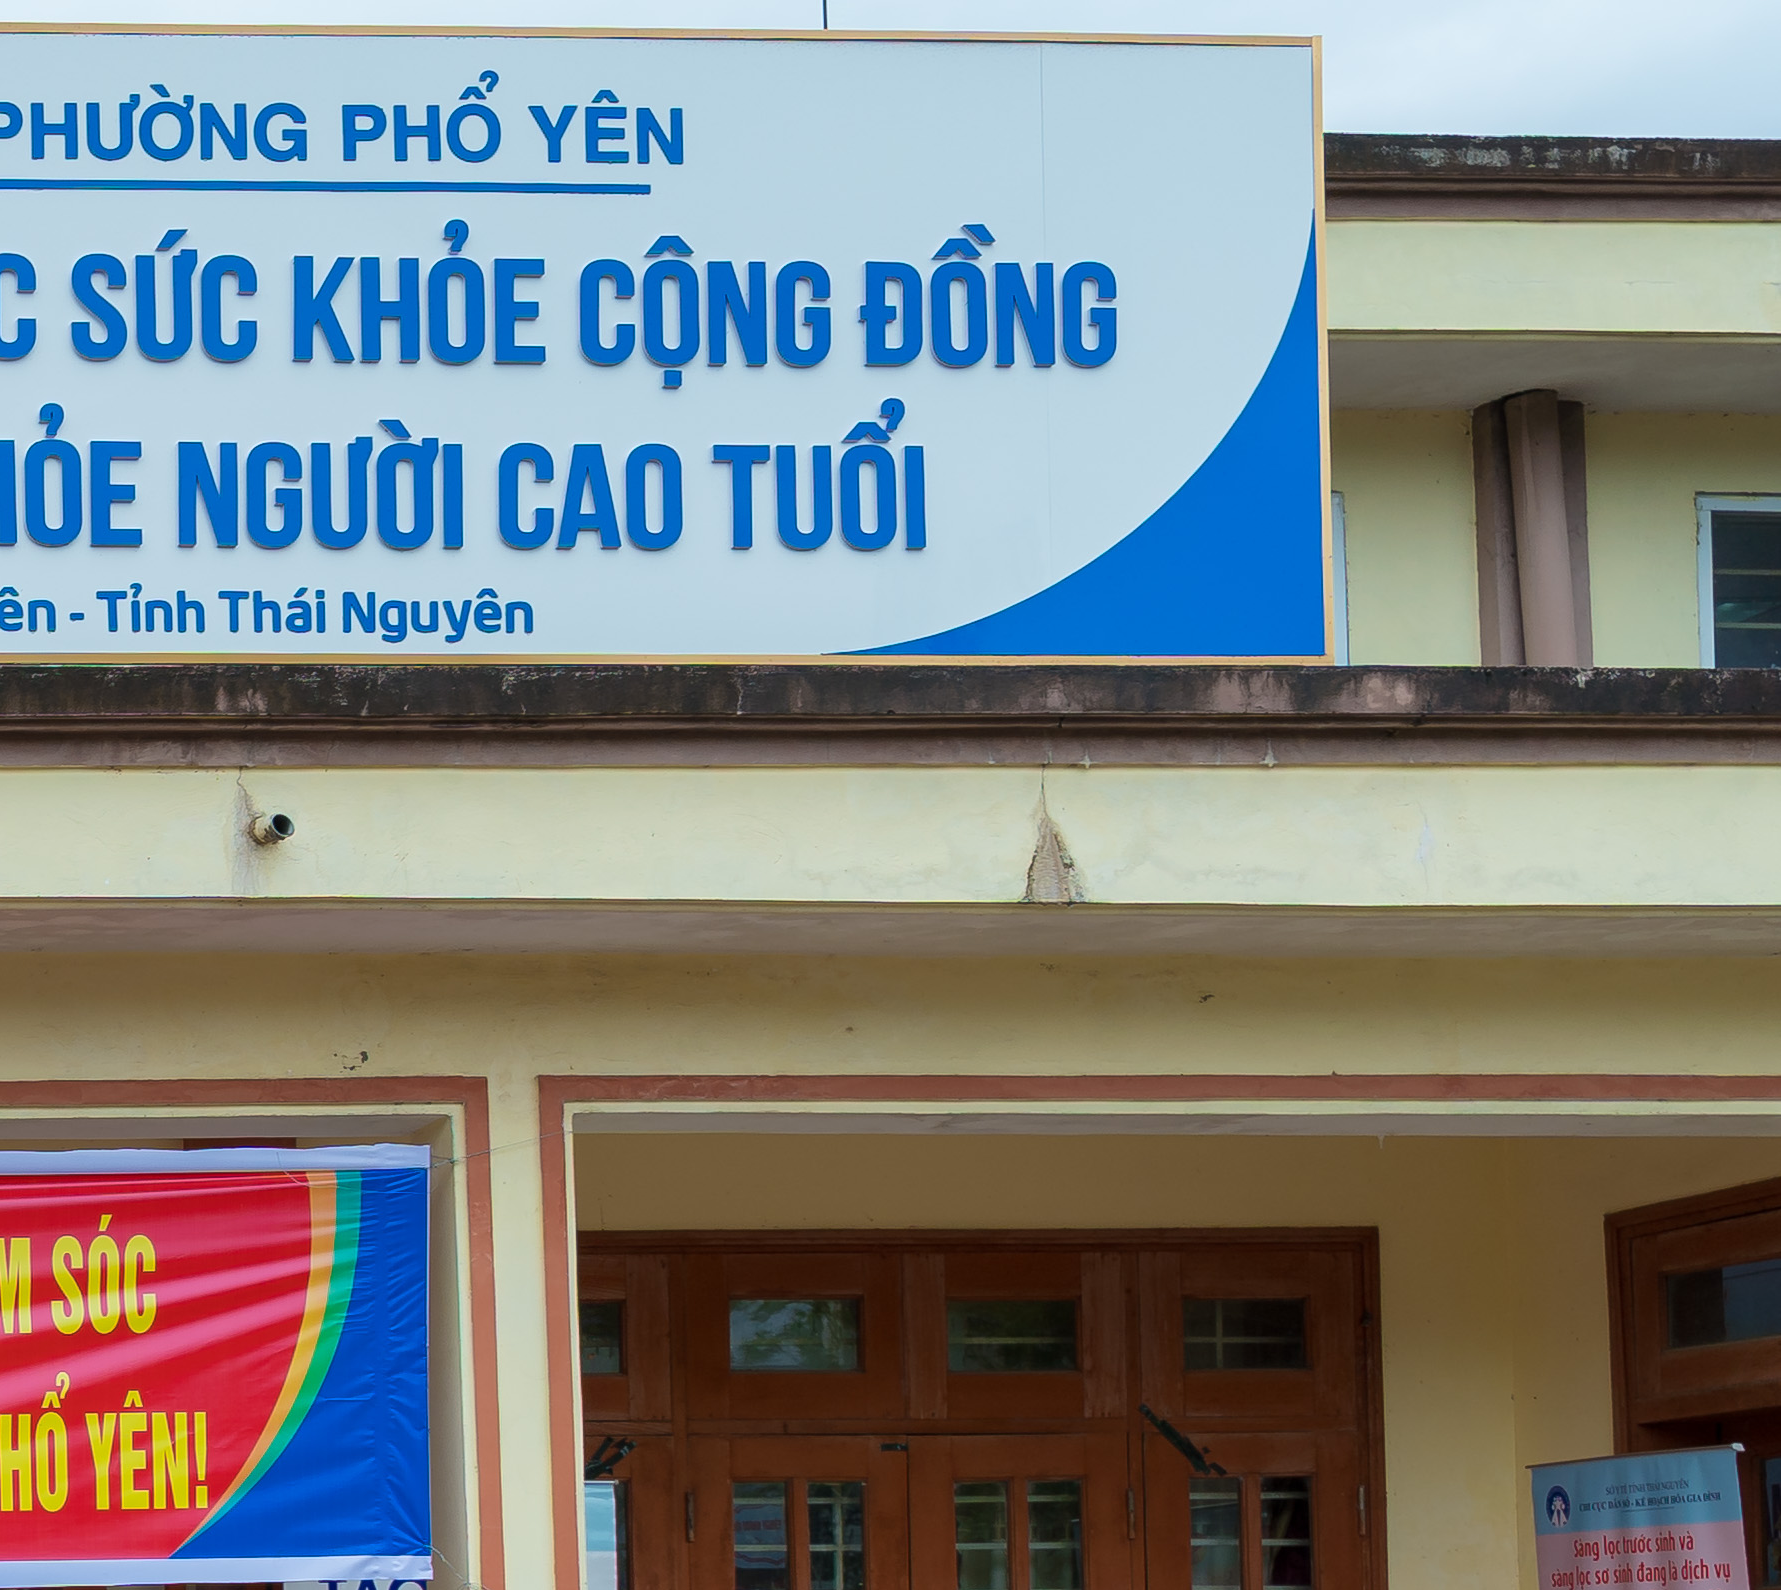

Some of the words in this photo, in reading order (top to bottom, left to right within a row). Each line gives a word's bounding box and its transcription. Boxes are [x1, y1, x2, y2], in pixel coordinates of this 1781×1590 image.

[341, 69, 502, 163] PHỔ
[527, 89, 684, 165] YÊN
[70, 229, 258, 364] SỨC
[292, 219, 547, 365] KHỎE
[579, 235, 832, 390] CỘNG
[858, 223, 1118, 369] ĐỒNG
[177, 419, 464, 549] NGƯỜI
[498, 442, 684, 550] CAO
[712, 397, 927, 551] TUỔI
[95, 582, 206, 634] Tỉnh
[217, 586, 326, 634] Thái
[342, 587, 534, 644] Nguyên
[50, 1213, 158, 1335] SÓC
[85, 1389, 210, 1511] YÊN!
[1551, 1568, 1573, 1590] sàng
[1576, 1566, 1591, 1590] lọc
[1595, 1568, 1609, 1584] sơ
[1613, 1564, 1633, 1584] sinh
[1637, 1562, 1666, 1586] đang
[1669, 1560, 1678, 1580] là
[1681, 1559, 1709, 1584] dịch
[1714, 1563, 1731, 1583] vụ
[1573, 1538, 1599, 1561] Sàng
[1604, 1535, 1620, 1559] lọc
[1623, 1534, 1652, 1553] trước
[1655, 1530, 1675, 1552] sinh
[1679, 1531, 1694, 1550] và
